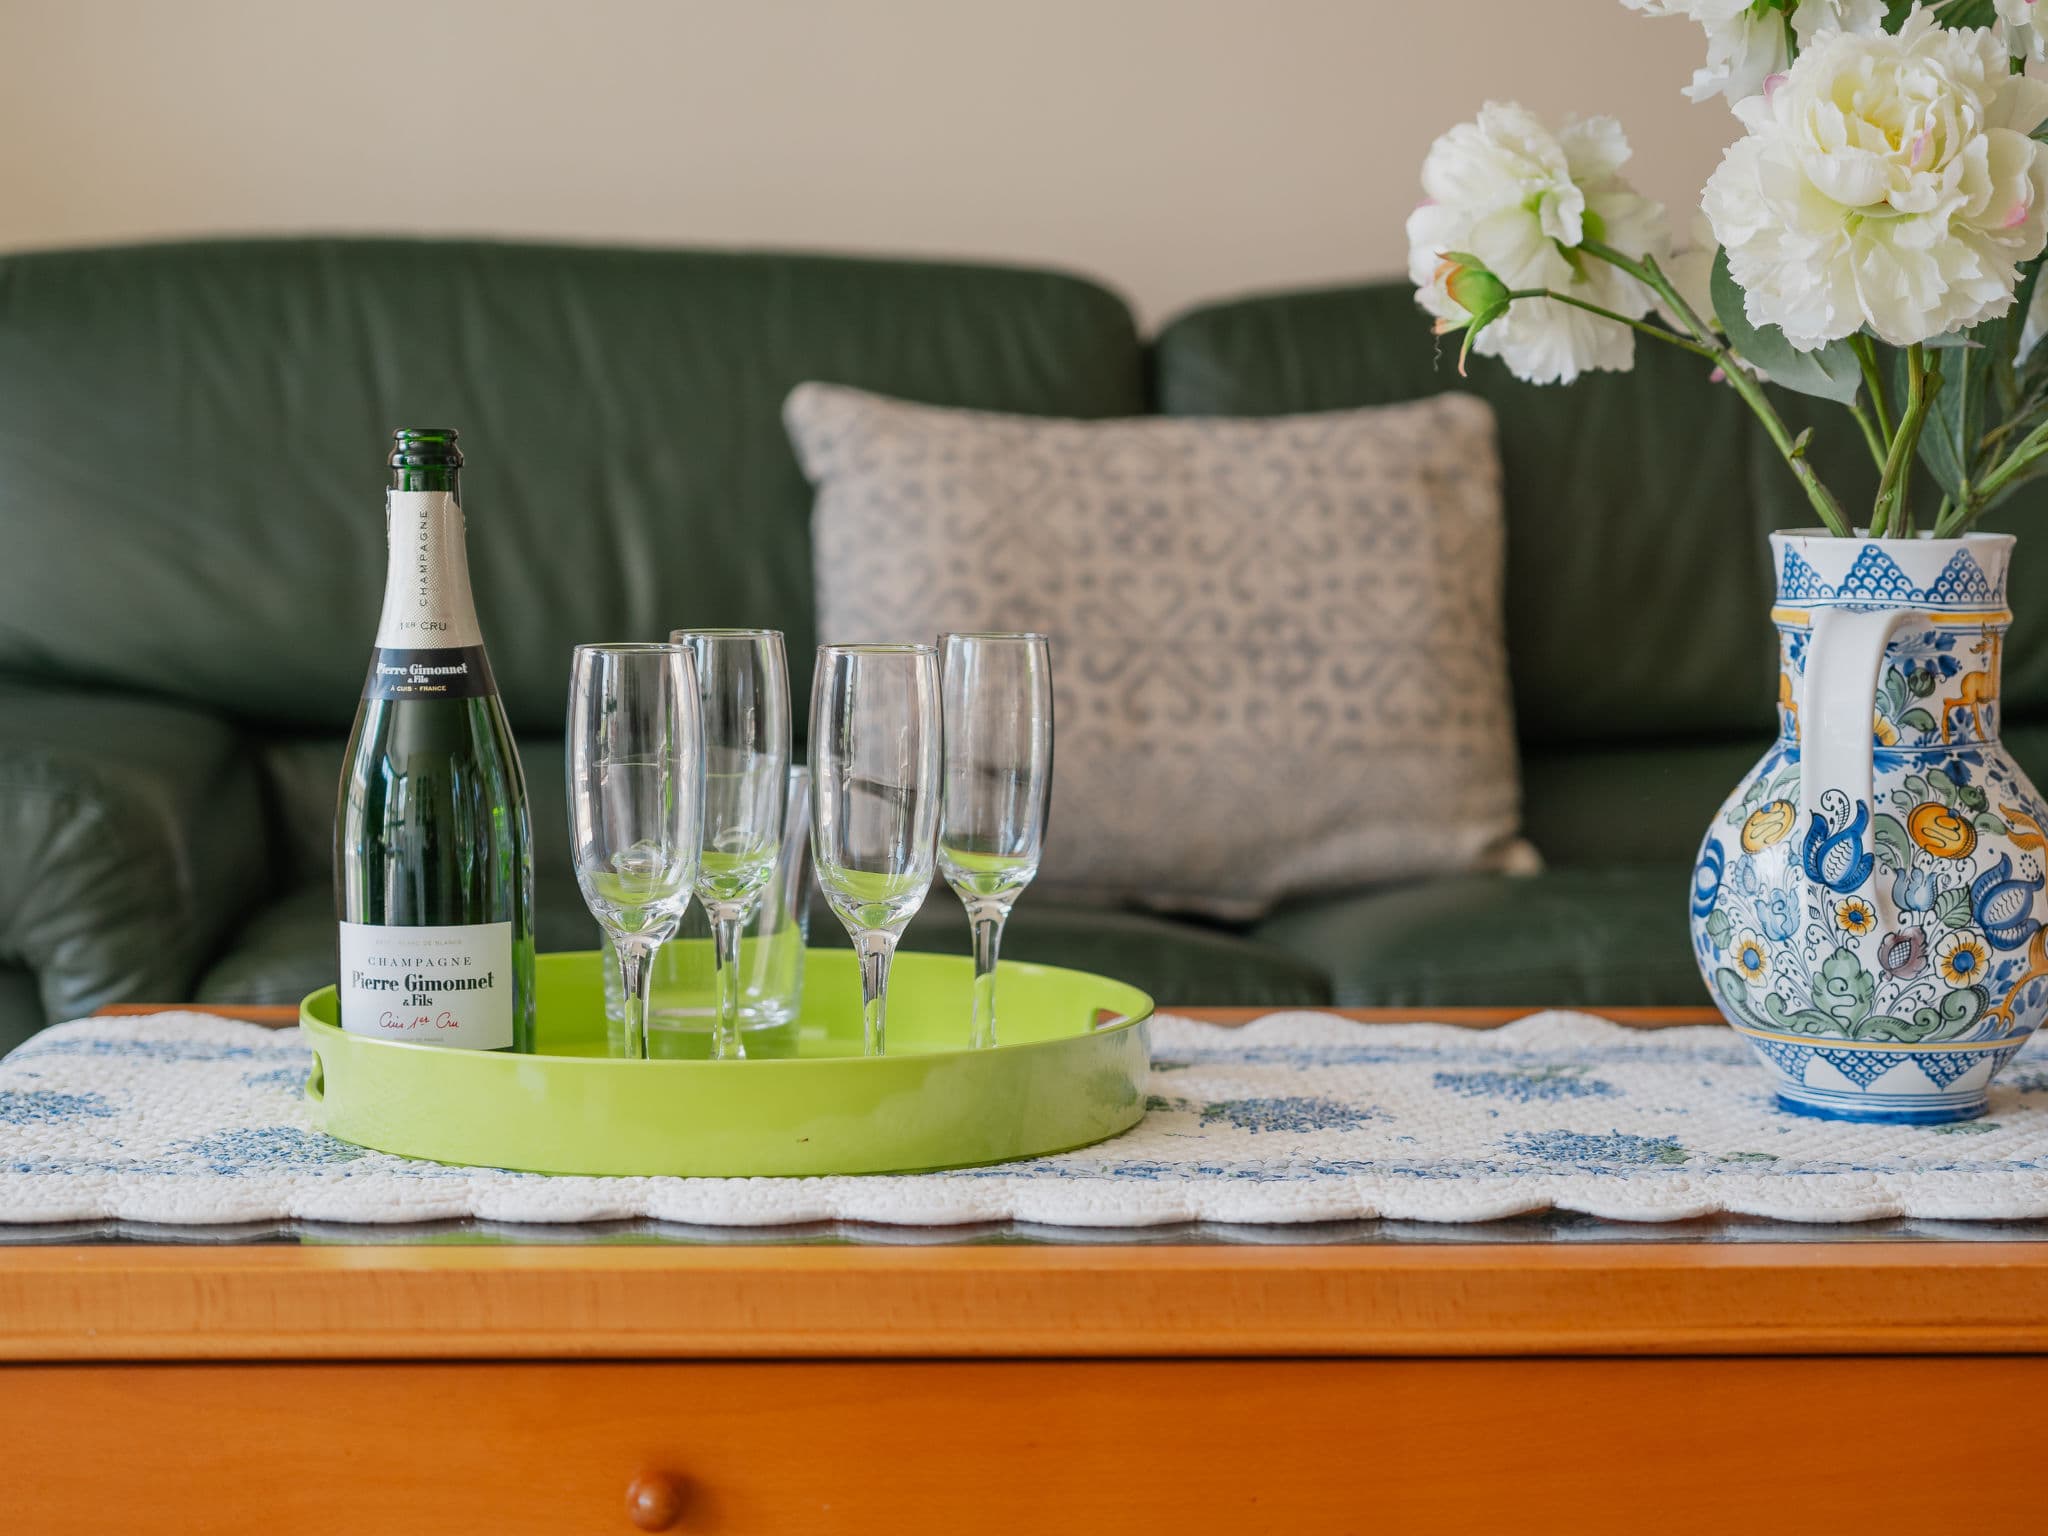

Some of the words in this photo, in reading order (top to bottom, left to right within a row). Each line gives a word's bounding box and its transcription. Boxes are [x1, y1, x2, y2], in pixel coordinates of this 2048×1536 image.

[419, 510, 429, 607] CHAMPAGNE
[420, 621, 447, 631] CRU
[376, 661, 407, 675] Pierre
[409, 662, 468, 675] Gimonnet
[414, 675, 429, 684] Fils
[367, 956, 473, 968] CHAMPAGNE
[352, 971, 399, 992] Pierre
[404, 971, 495, 992] Gimonnet
[402, 998, 410, 1007] &
[411, 993, 433, 1007] Fils
[435, 1011, 460, 1029] Cru
